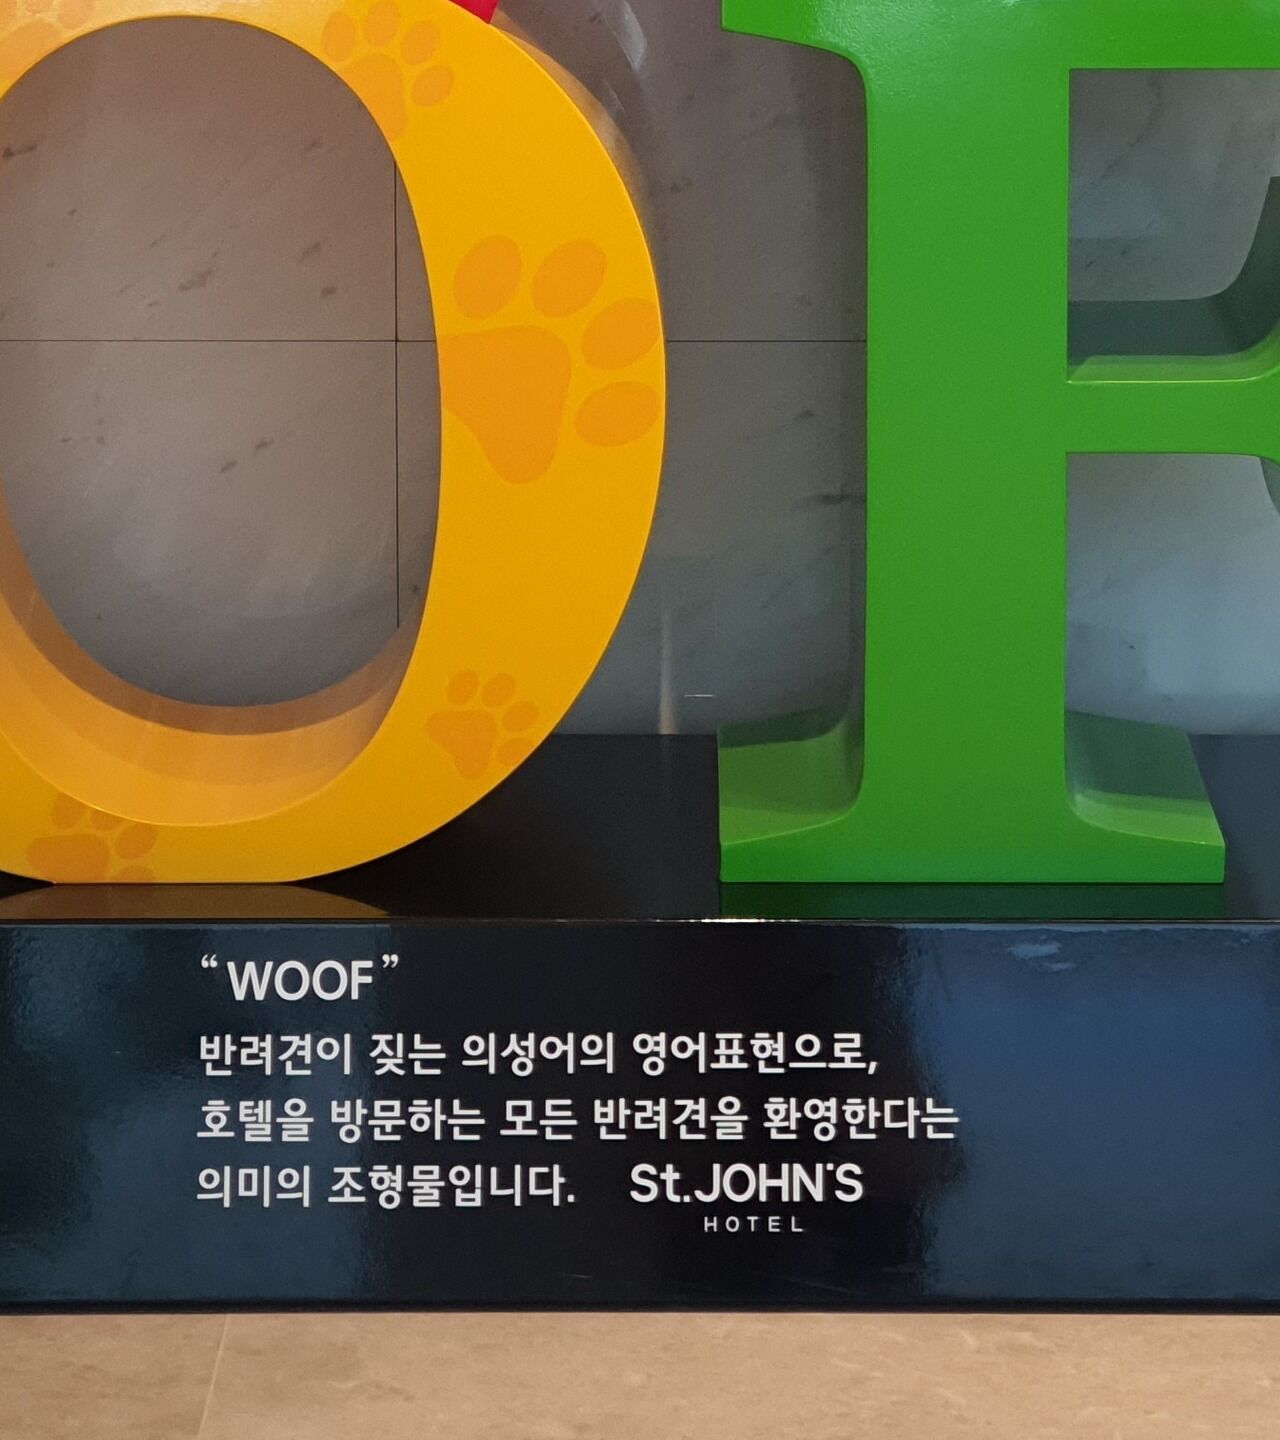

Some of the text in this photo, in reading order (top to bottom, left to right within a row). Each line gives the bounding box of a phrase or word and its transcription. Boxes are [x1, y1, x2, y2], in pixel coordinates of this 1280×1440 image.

[199, 1030, 879, 1078] 반려견이 짖는 의성어의 영어표현으로,
[195, 1094, 961, 1145] 호텔을 방문하는 모든 반려견을 환영한다는
[195, 1162, 576, 1211] 의미의 조형물입니다.
[703, 1214, 804, 1234] HOTEL
